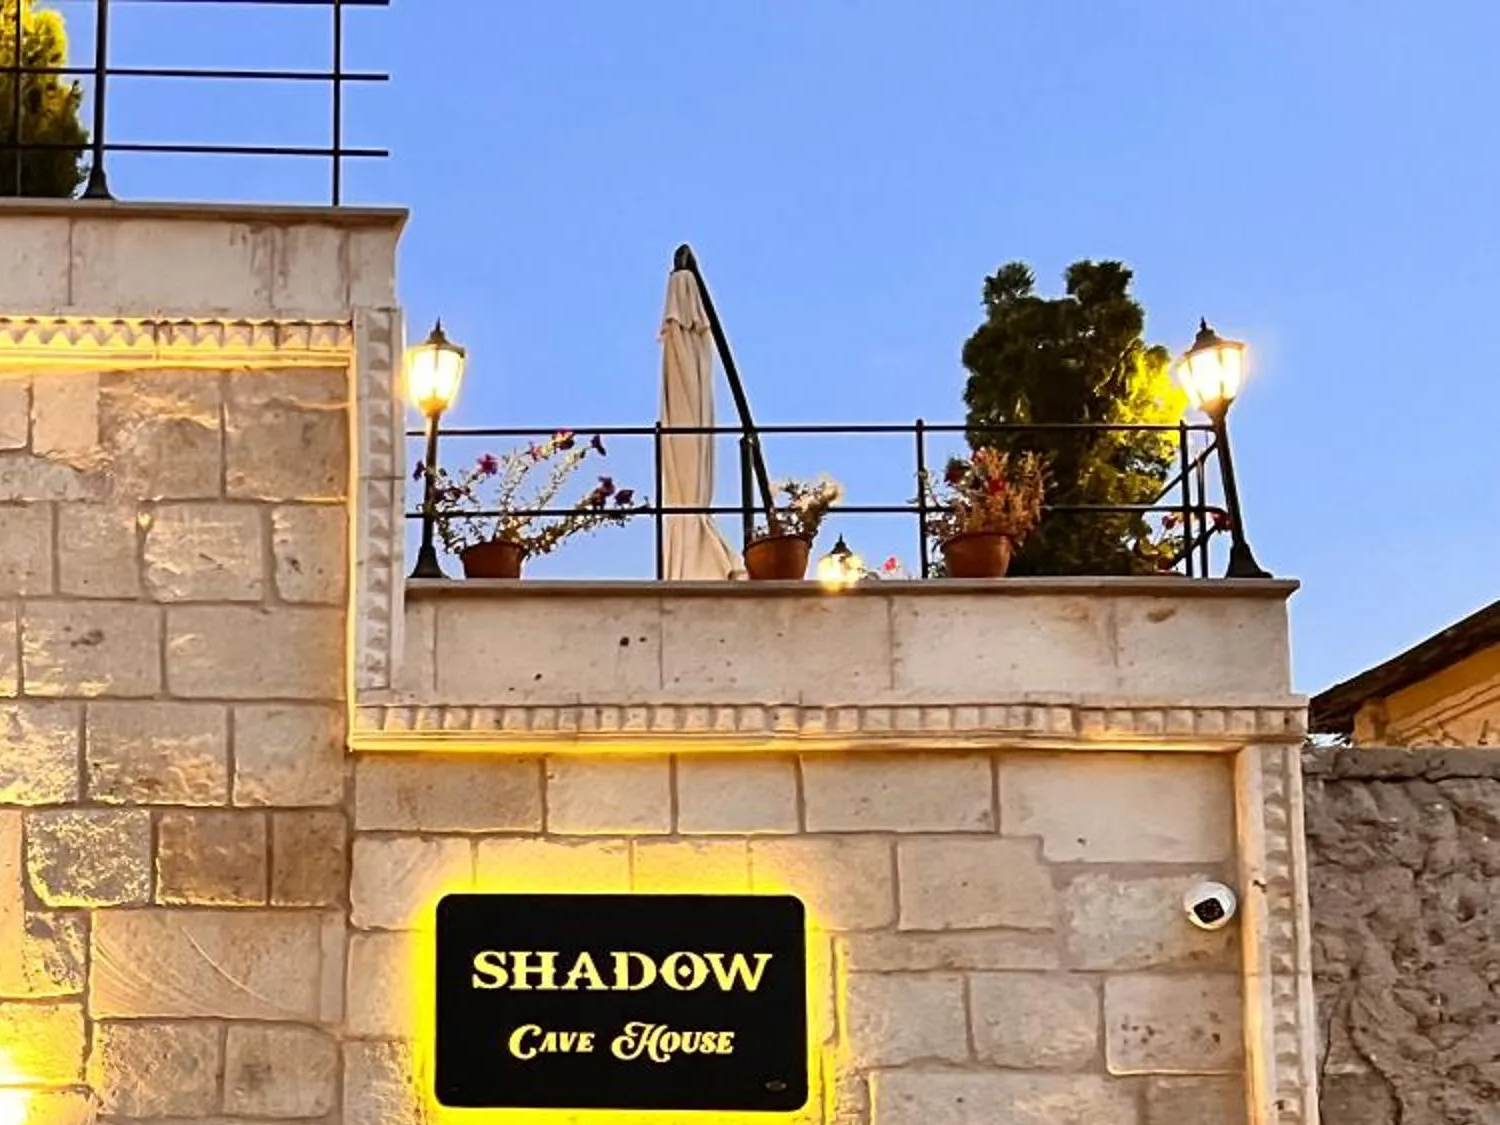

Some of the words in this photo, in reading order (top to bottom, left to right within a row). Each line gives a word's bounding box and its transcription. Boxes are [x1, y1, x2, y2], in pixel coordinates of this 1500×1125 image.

[472, 950, 773, 992] SHADOW
[508, 1024, 595, 1060] CAVE
[611, 1021, 735, 1063] HOUSE
